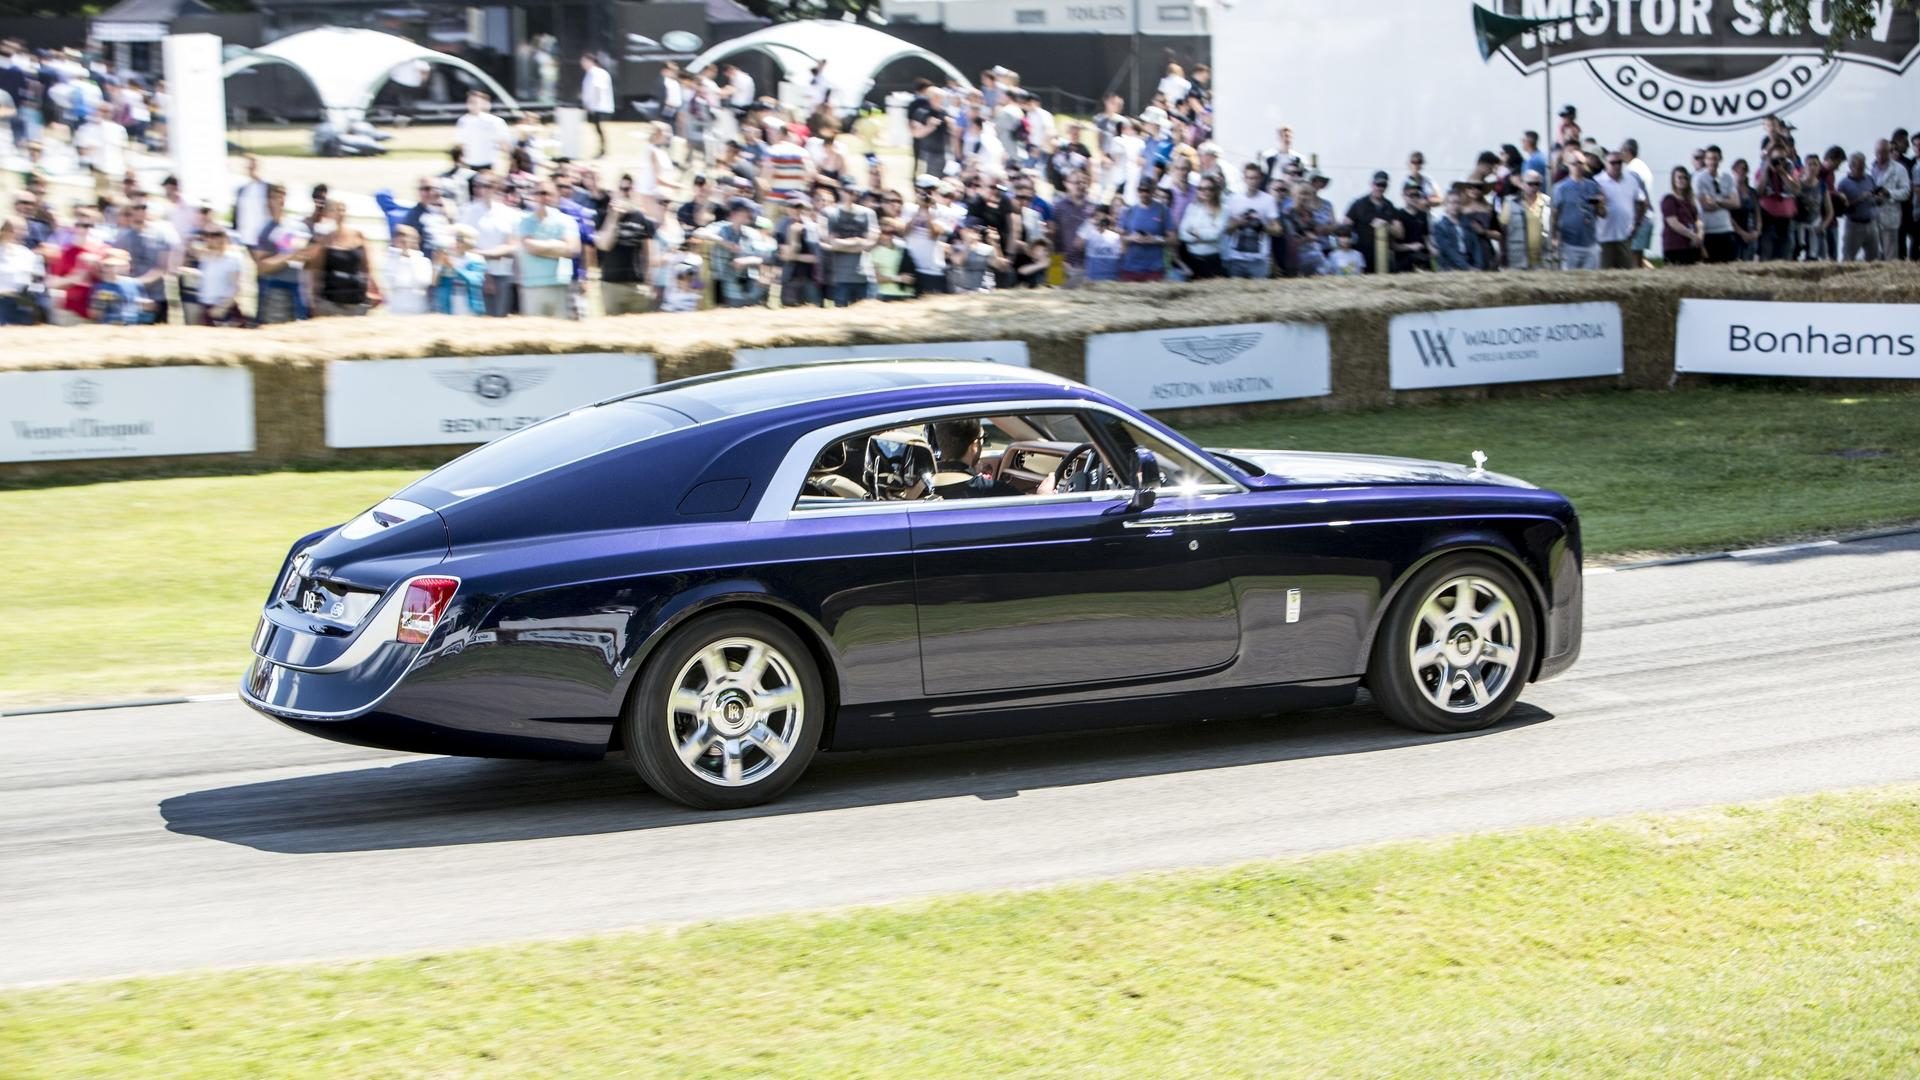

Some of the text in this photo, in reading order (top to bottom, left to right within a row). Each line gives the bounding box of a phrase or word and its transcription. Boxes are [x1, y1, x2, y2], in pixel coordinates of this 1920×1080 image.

[1066, 5, 1126, 20] TOILETS
[1520, 0, 1713, 49] MOTOR
[1616, 65, 1812, 115] GOODWOOD
[1462, 323, 1605, 345] WALDORF ASTORIA
[1729, 324, 1915, 356] Bonhams
[1151, 376, 1274, 399] ASTON MARTIN
